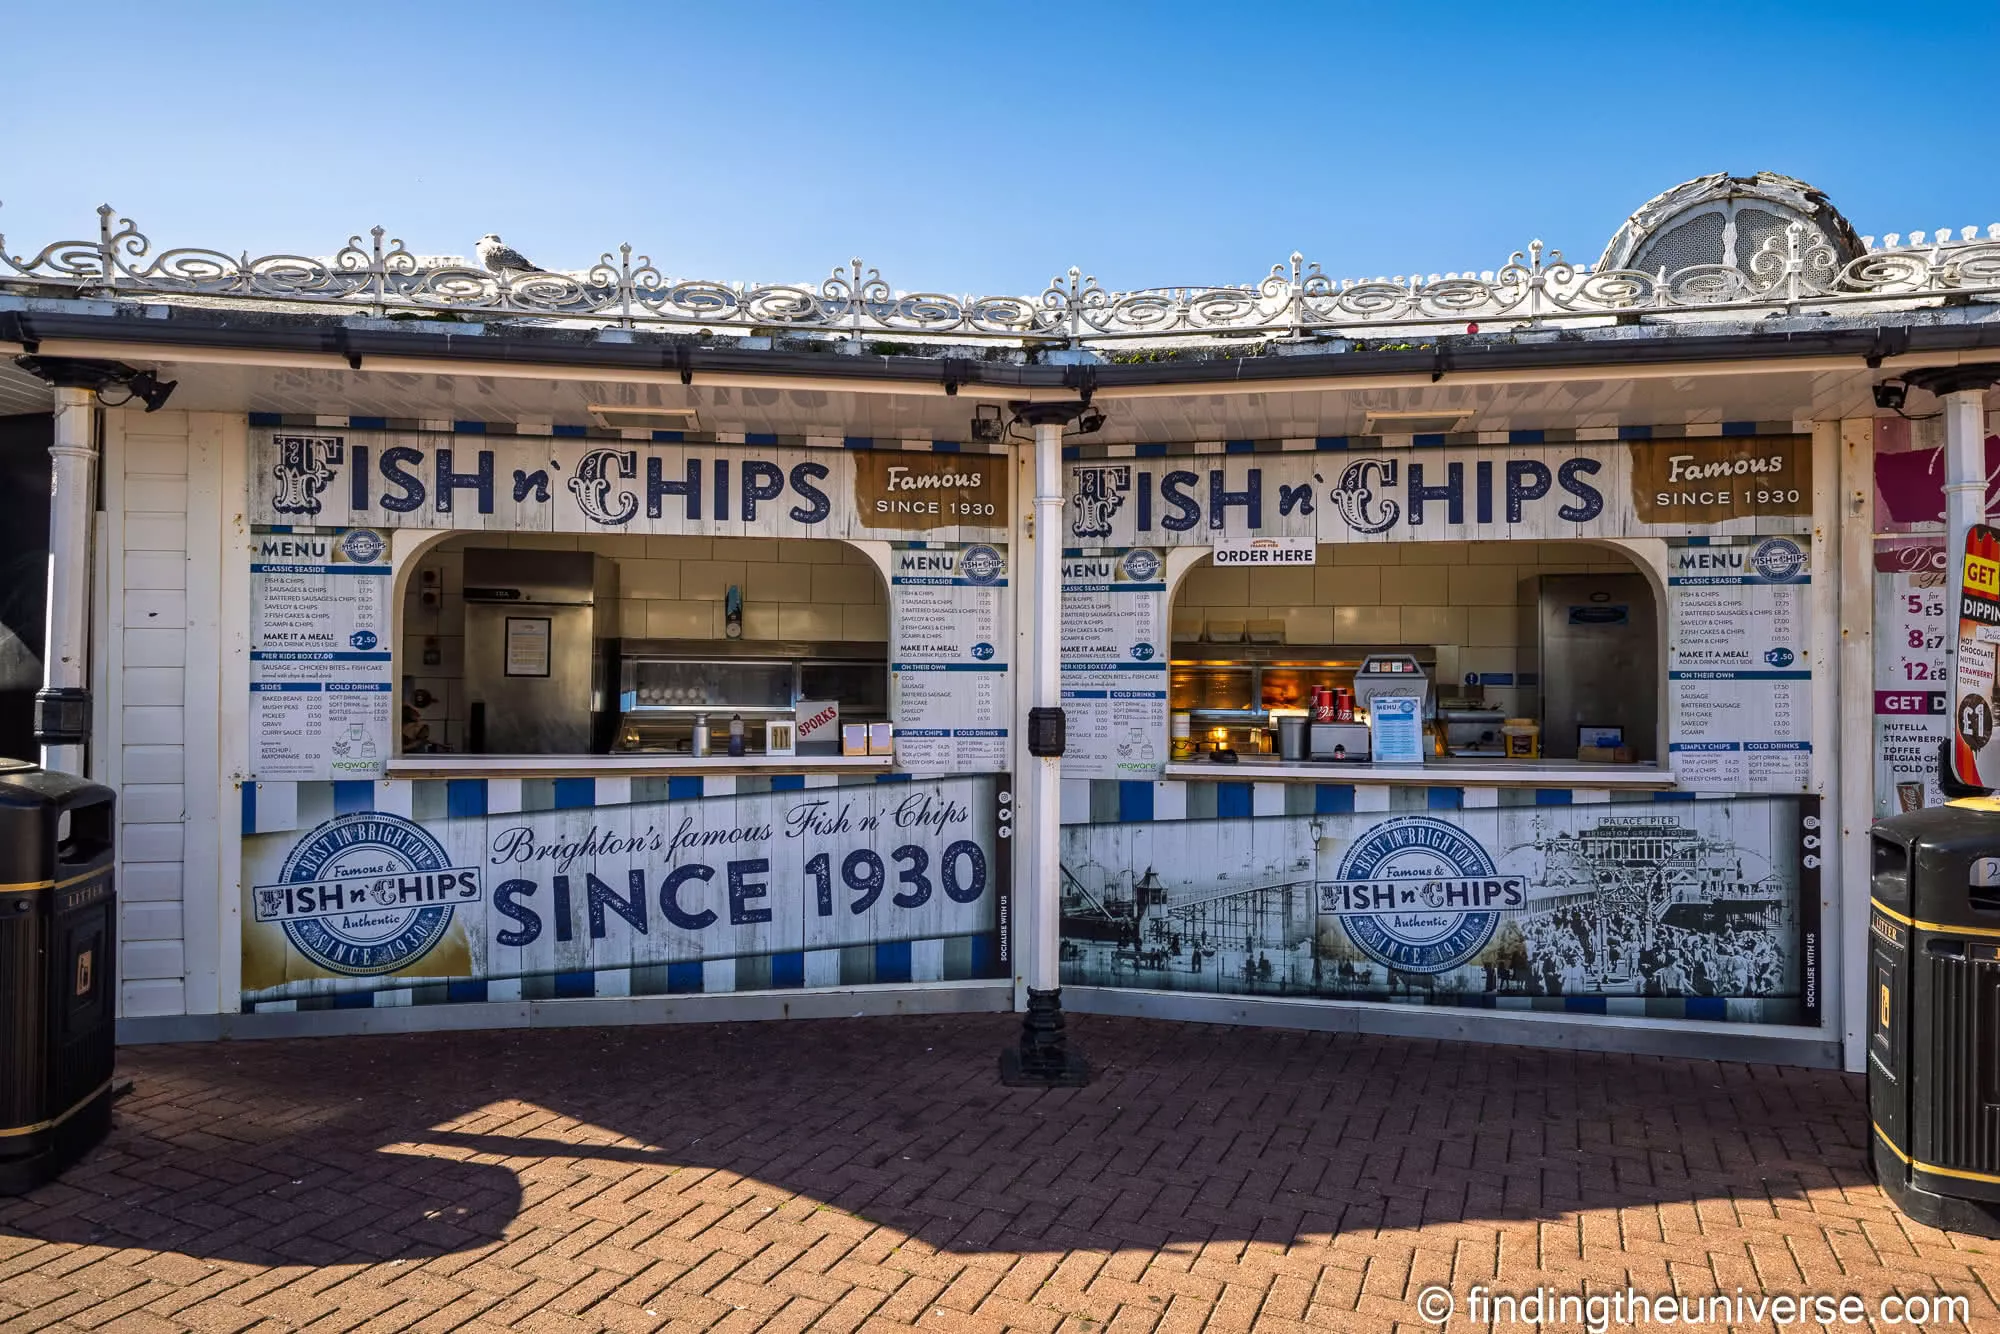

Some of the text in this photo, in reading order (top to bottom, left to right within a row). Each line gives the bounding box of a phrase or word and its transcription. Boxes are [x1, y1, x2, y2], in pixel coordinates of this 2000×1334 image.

[1668, 455, 1783, 483] Famous
[272, 434, 494, 516] FISH
[568, 448, 832, 525] CHIPS
[887, 465, 981, 492] Famous
[1073, 465, 1262, 538] FISH
[1330, 457, 1604, 534] CHIPS
[1656, 490, 1800, 506] SINCE 1930
[876, 499, 995, 516] SINCE 1930
[260, 542, 326, 558] MENU
[1216, 550, 1312, 562] ORDER HERE
[900, 556, 953, 570] MENU
[1679, 554, 1742, 569] MENU
[1061, 564, 1109, 578] MENU
[1968, 563, 1995, 585] GET
[1908, 595, 1922, 613] 5
[1928, 592, 1939, 601] for
[1926, 603, 1944, 616] £5
[1928, 624, 1938, 634] for
[1908, 630, 1924, 648] 8
[1927, 636, 1944, 648] £7
[1960, 646, 1994, 659] CHOCOLATE
[1933, 659, 1944, 668] for
[1960, 656, 1984, 667] NUTELLA
[1904, 663, 1928, 680] 12
[1930, 668, 1946, 680] £8
[1960, 665, 1993, 680] STRAWBERRY
[1960, 676, 1980, 687] TOFFEE
[1885, 696, 1922, 710] GET
[798, 706, 837, 737] SPORKS
[1962, 703, 1984, 736] £1
[332, 761, 379, 771] vegware
[491, 825, 662, 874] Brighton's
[664, 816, 773, 863] famous
[785, 800, 852, 838] Fish
[890, 792, 969, 836] Chips
[302, 822, 427, 872] BEST IN BRIGHTON
[1356, 828, 1476, 871] BEST IN BRIGHTON
[334, 862, 397, 878] Famous &
[1386, 866, 1444, 878] Famous &
[260, 884, 344, 917] FISH
[370, 872, 477, 906] CHIPS
[493, 840, 986, 947] SINCE 1930
[1001, 896, 1007, 904] US
[1320, 884, 1395, 910] FISH
[1420, 880, 1521, 909] CHIPS
[342, 913, 400, 930] Authentic
[1394, 914, 1448, 928] Authentic
[312, 926, 428, 965] SINCE 1930
[1368, 928, 1475, 964] SINCE 1930
[1808, 934, 1814, 944] US
